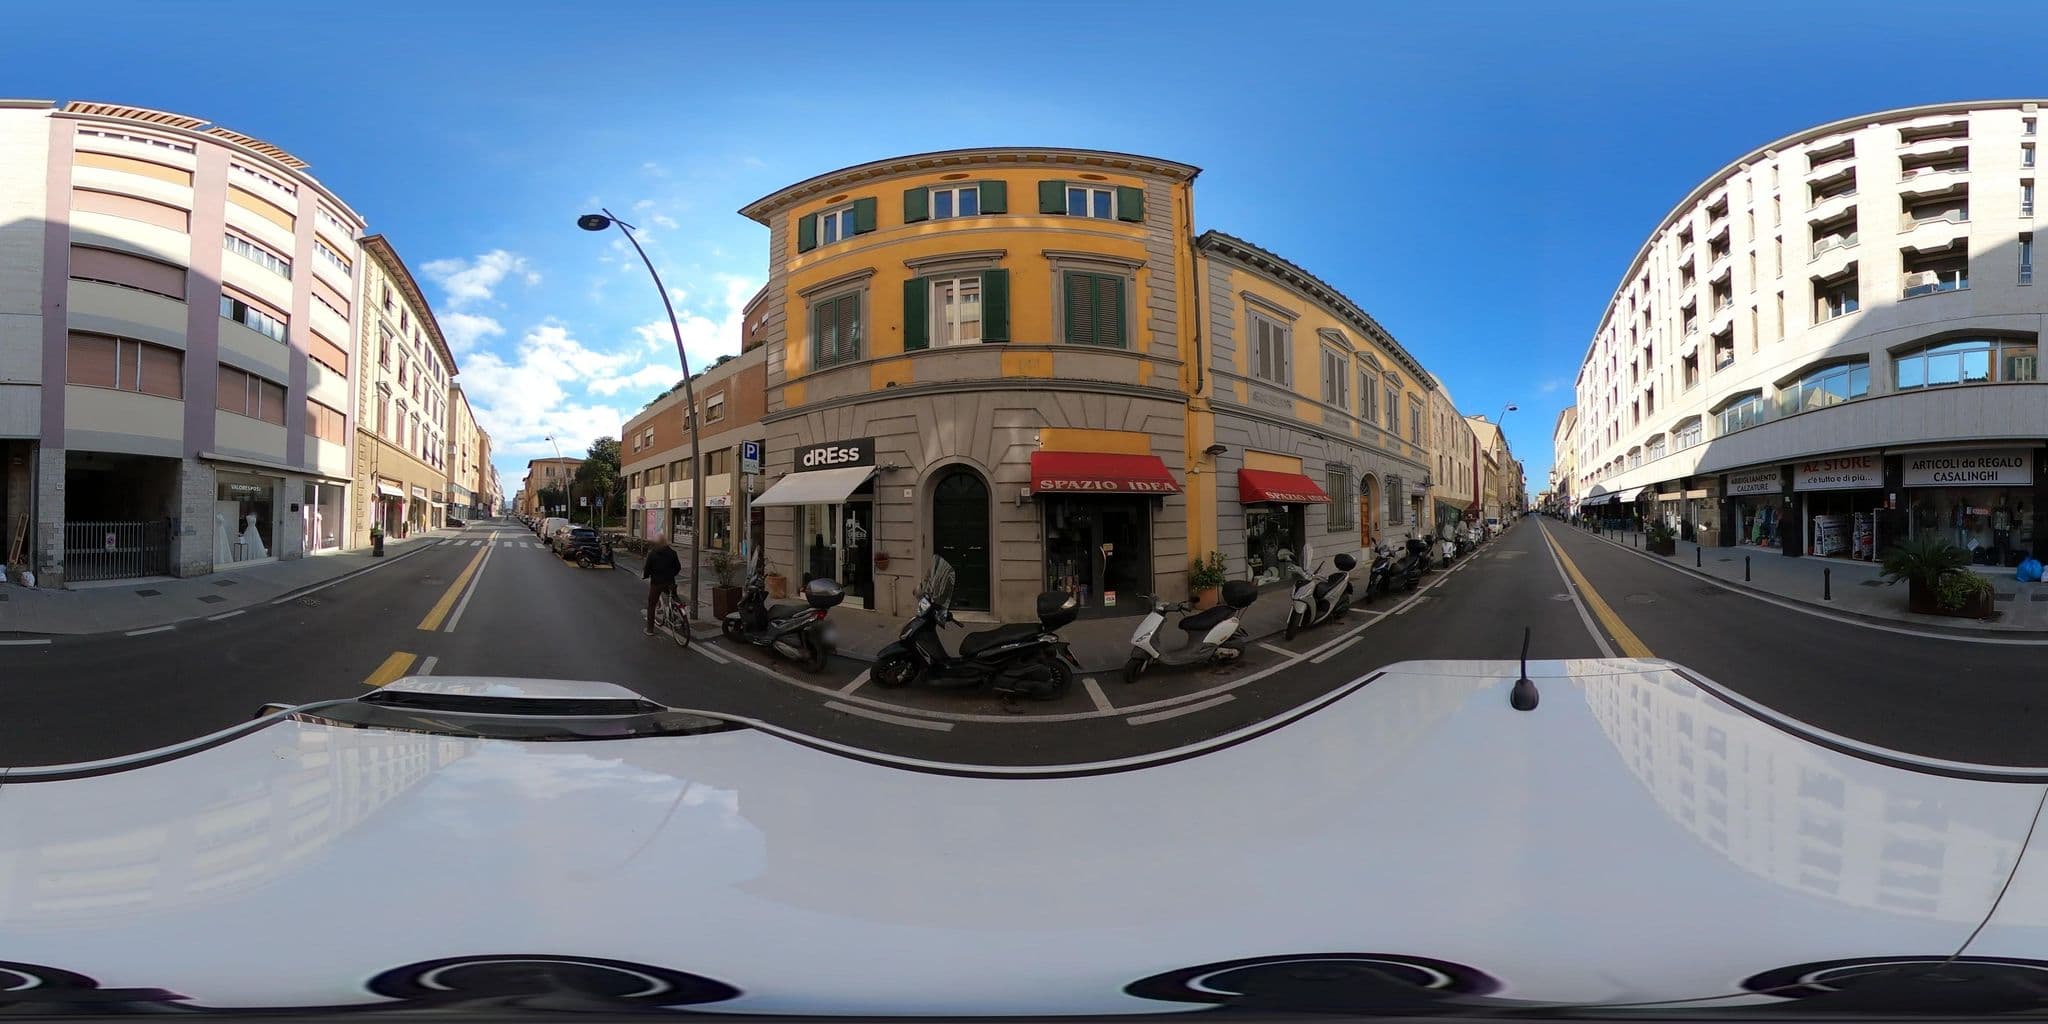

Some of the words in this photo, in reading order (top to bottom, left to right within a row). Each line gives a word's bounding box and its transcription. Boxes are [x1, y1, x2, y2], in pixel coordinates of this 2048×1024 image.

[1824, 456, 1872, 471] STORE
[1912, 459, 1960, 470] ARTICOLI
[1962, 459, 1976, 469] da
[1978, 457, 2023, 468] REGALO
[1933, 471, 1998, 482] CASALINGHI
[1040, 480, 1118, 491] SPAZIO
[1128, 480, 1177, 491] IDEA
[1737, 483, 1769, 492] CALZATURE
